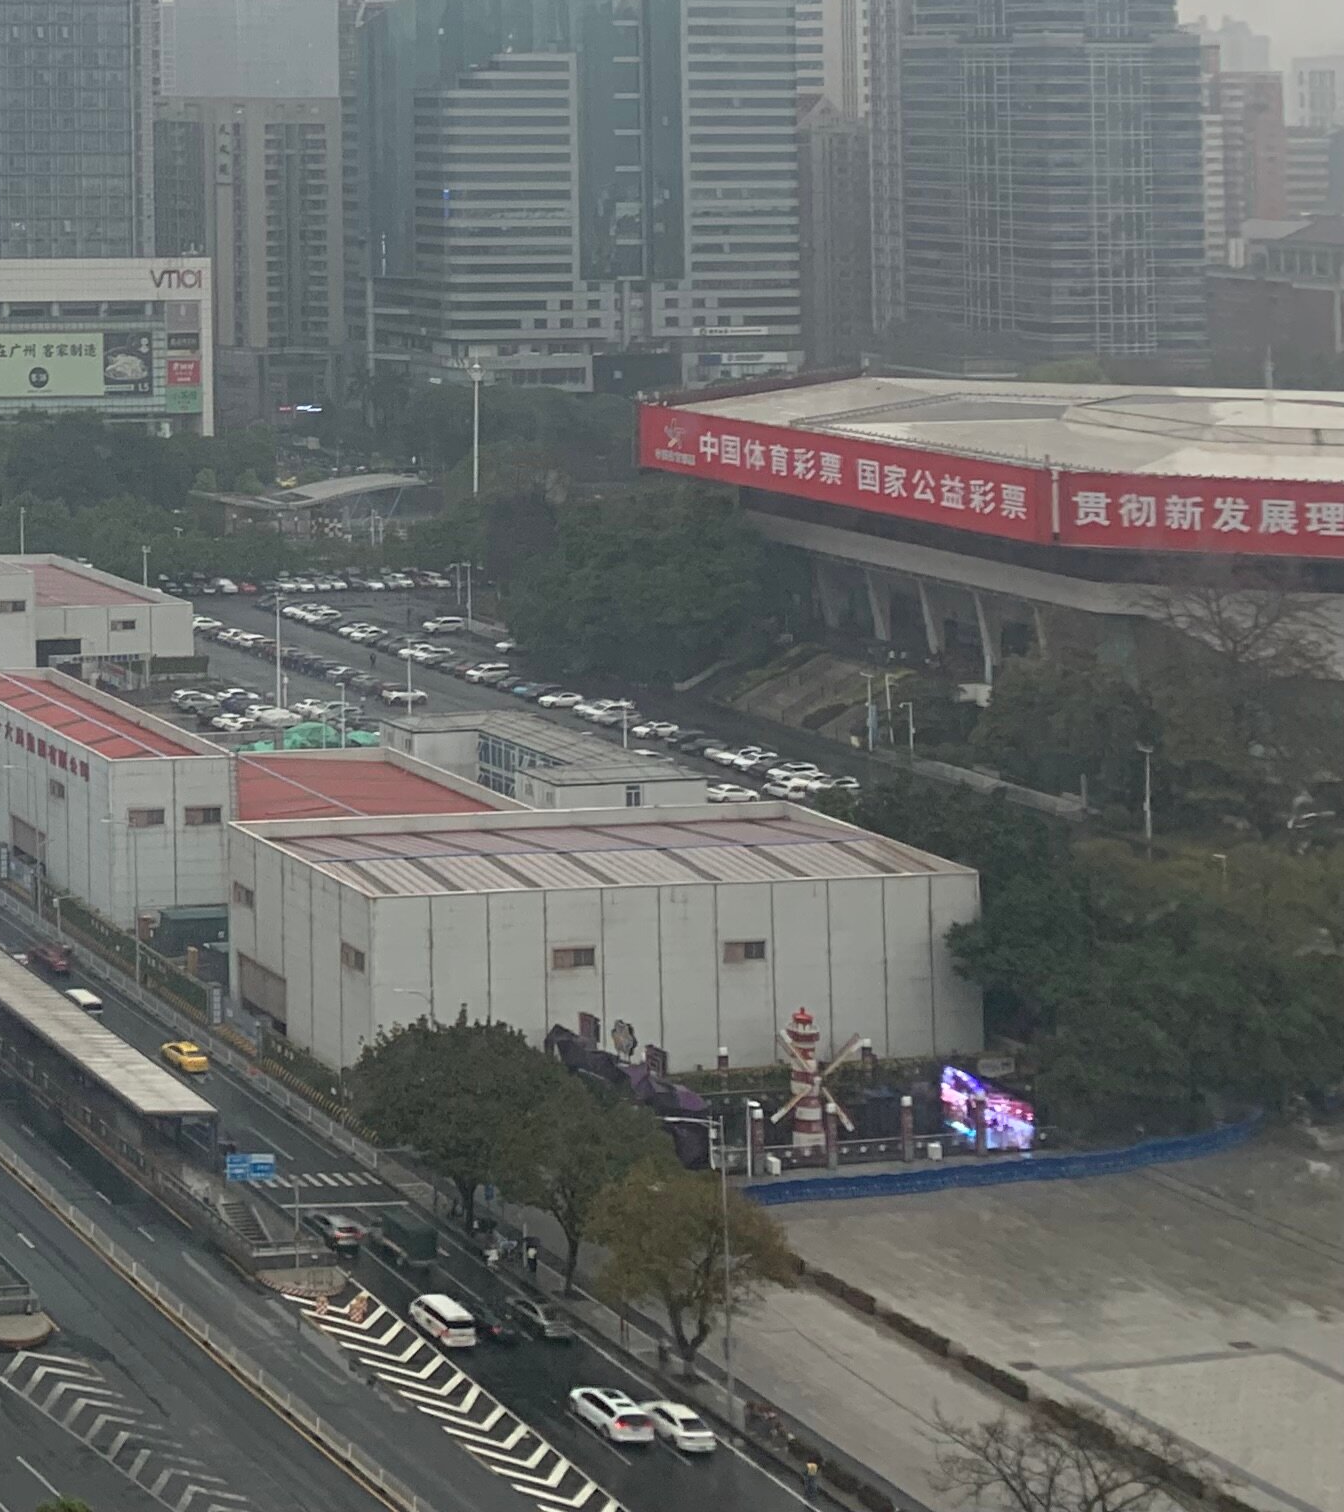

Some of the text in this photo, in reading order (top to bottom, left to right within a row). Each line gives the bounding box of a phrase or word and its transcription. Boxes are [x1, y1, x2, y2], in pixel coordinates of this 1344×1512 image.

[42, 343, 97, 358] 客家制造
[699, 431, 1028, 520] 中国体育彩票 国家公益彩票
[1072, 491, 1344, 537] 贯彻新发展理
